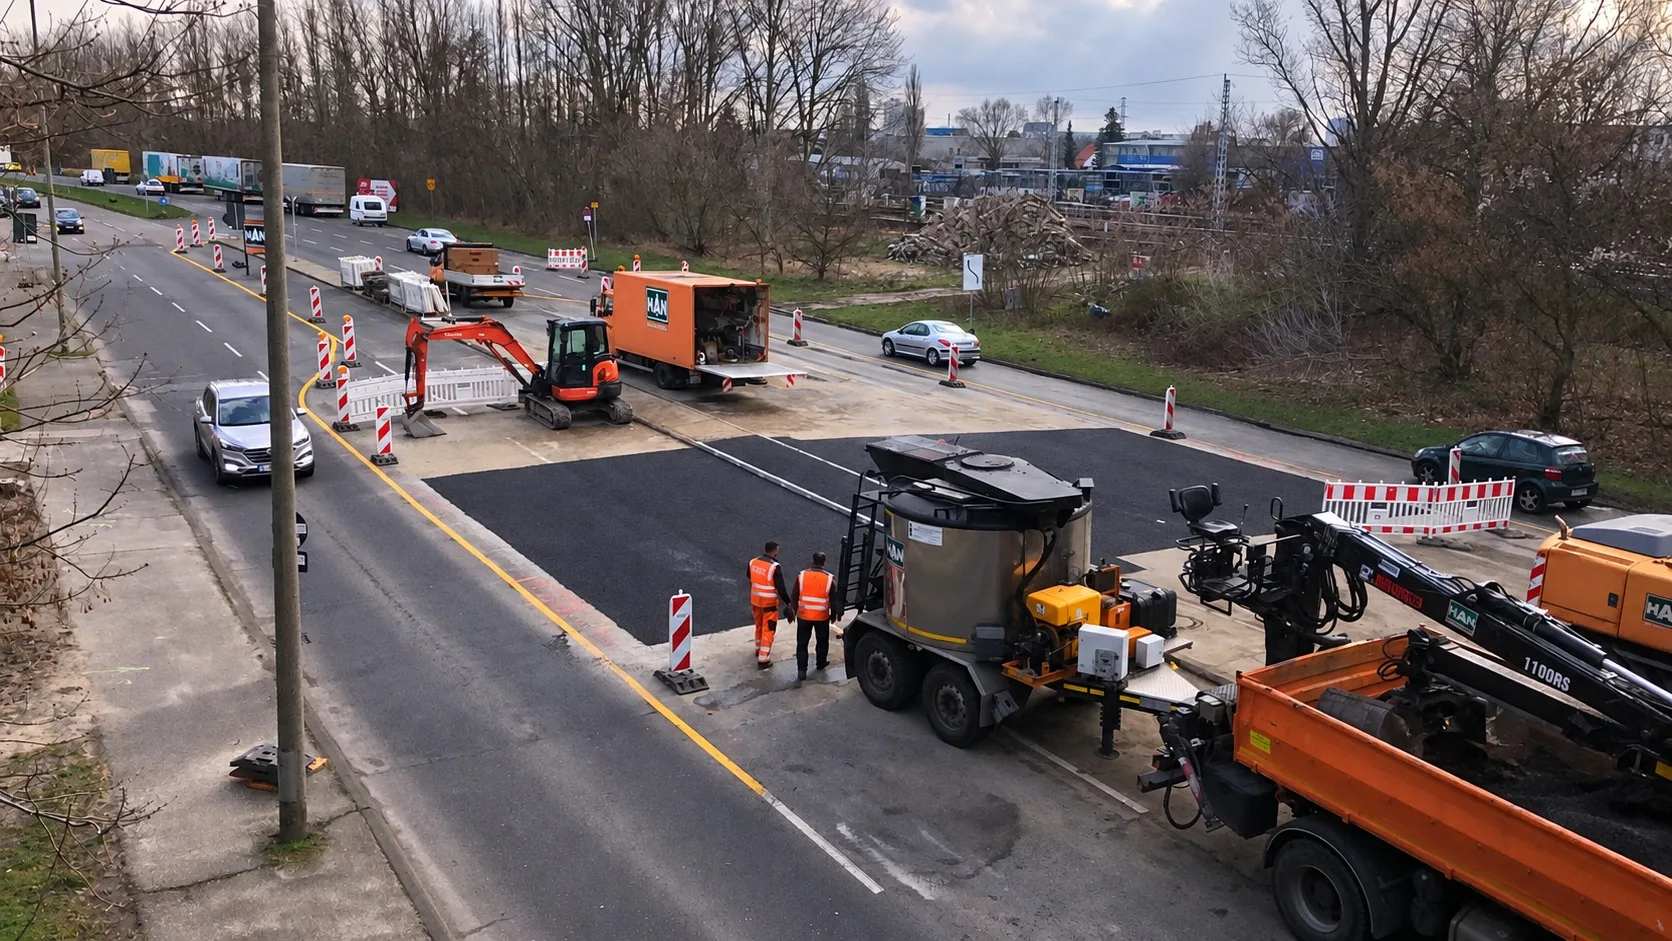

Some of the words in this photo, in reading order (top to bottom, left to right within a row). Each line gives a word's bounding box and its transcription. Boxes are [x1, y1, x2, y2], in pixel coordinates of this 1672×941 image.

[648, 293, 667, 316] HAN
[1449, 605, 1476, 628] HAN
[1524, 656, 1571, 692] 1100RS
